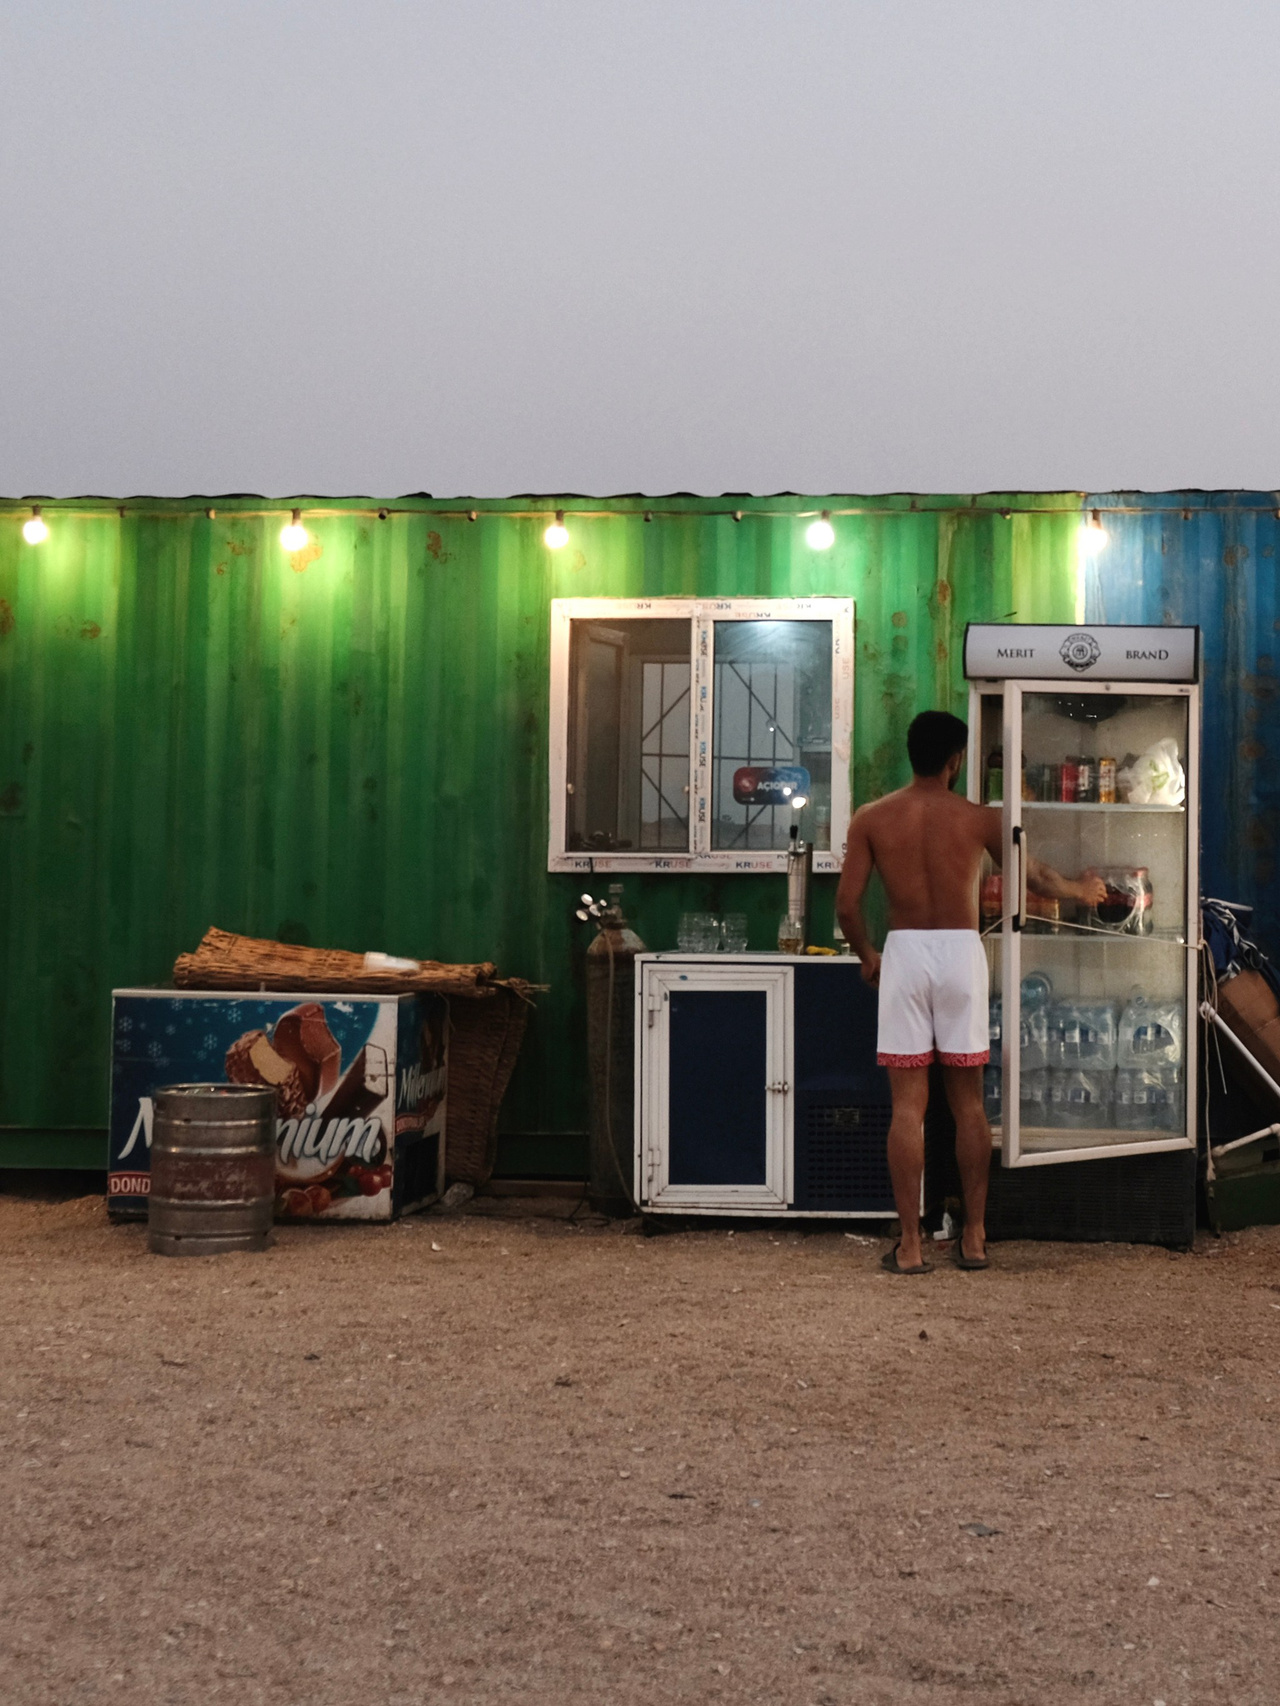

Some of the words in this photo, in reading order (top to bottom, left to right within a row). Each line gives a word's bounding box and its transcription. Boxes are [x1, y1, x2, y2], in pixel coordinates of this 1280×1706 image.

[996, 648, 1036, 659] MERIT
[1126, 649, 1169, 660] BRAND
[655, 859, 692, 869] KRUSE
[735, 861, 773, 869] KRUSE
[111, 1177, 150, 1193] DOND
